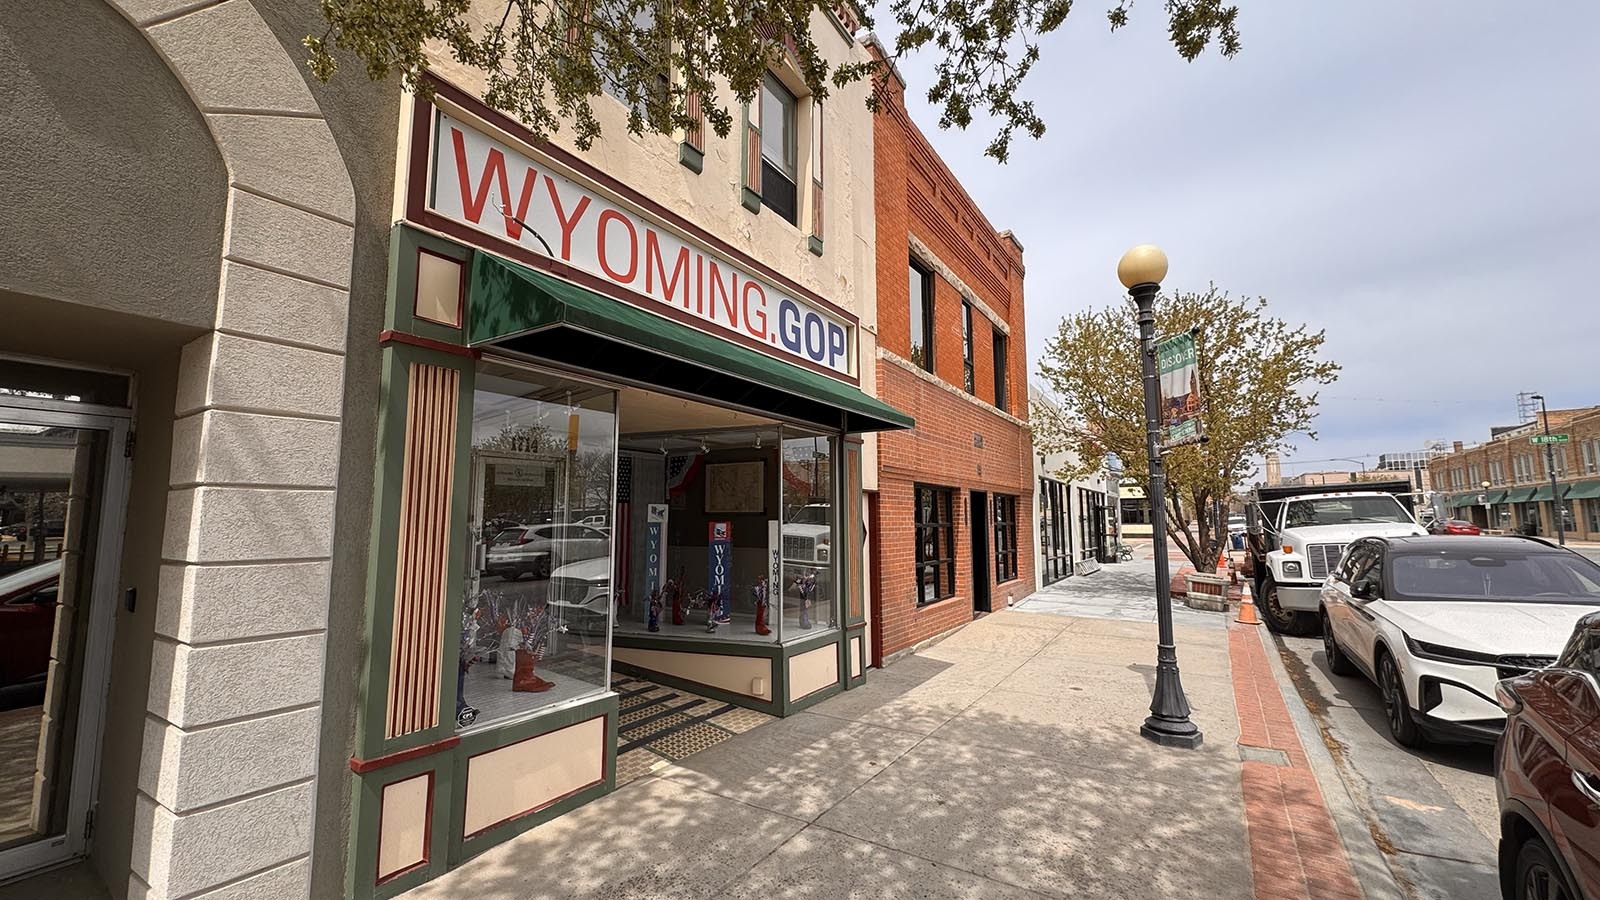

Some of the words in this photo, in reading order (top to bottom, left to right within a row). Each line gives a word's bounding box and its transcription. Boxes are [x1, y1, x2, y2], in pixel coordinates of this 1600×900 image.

[450, 126, 846, 370] WYOMING.GOP
[1161, 347, 1195, 369] DISCOVER
[649, 526, 660, 590] WYOMI
